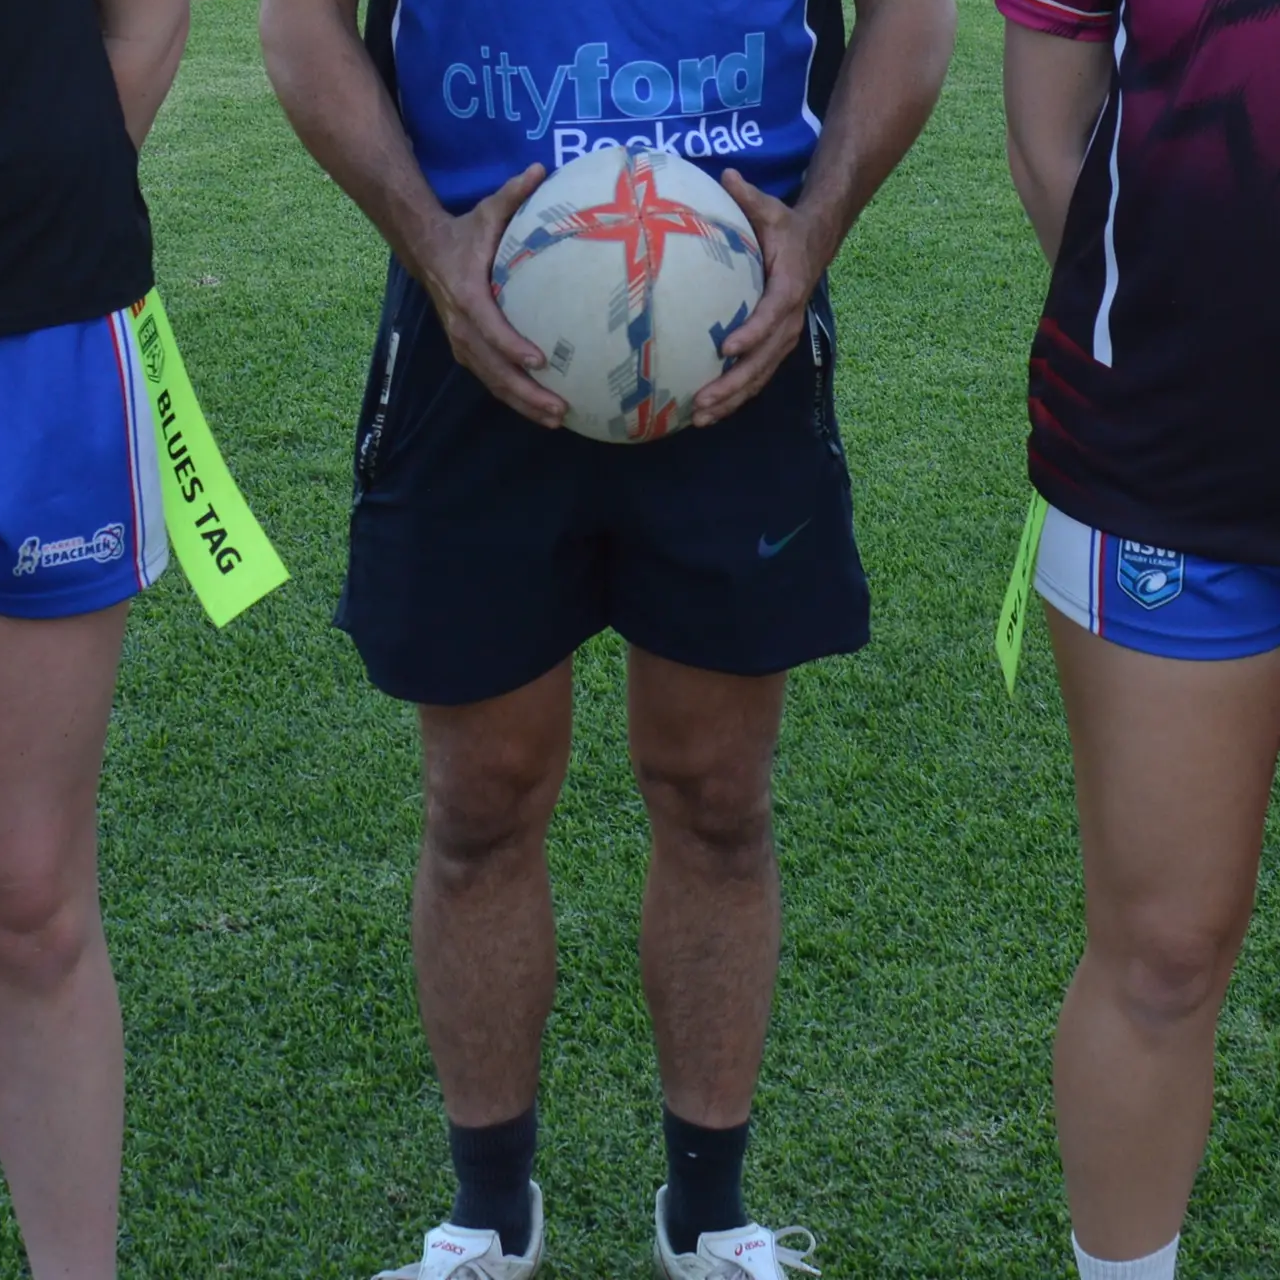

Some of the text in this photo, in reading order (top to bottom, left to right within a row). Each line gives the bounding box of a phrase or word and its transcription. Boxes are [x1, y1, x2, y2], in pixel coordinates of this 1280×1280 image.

[156, 388, 242, 576] BLUES TAG
[43, 542, 111, 565] SPACEMEN
